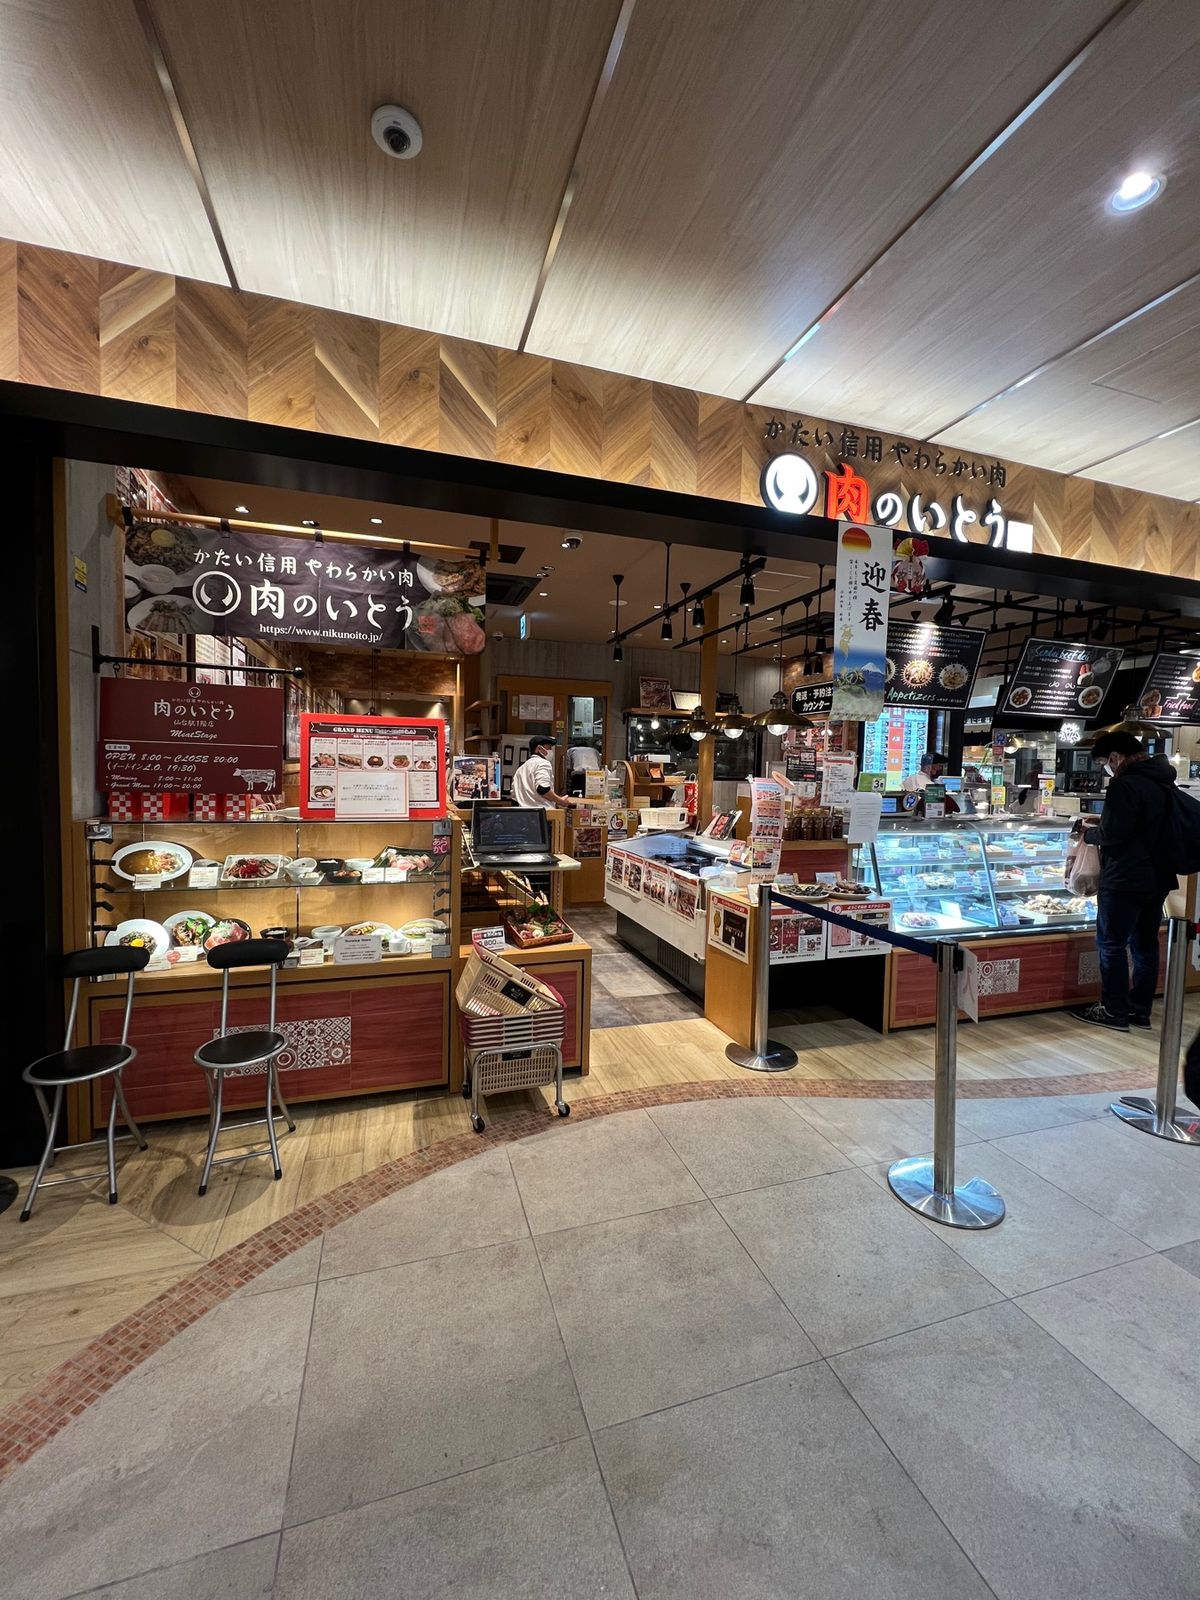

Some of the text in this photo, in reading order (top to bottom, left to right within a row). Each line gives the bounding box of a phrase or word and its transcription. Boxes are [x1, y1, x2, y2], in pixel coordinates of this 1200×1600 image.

[764, 416, 1007, 488] かたい信用 やわらかい肉
[823, 462, 1008, 548] 肉のいとう
[193, 548, 414, 588] かたい信用 やわらかい肉
[250, 578, 413, 631] 肉のいとう
[859, 561, 887, 632] 迎春
[259, 623, 384, 644] https://www.nikunoito.jp/
[796, 686, 834, 702] 発送・予約注
[886, 686, 936, 701] Appetizers
[154, 699, 236, 721] 肉のいとう
[802, 700, 830, 712] カウンター
[104, 752, 137, 761] OPEN
[173, 755, 210, 763] CLOSE
[213, 756, 239, 764] 20:00
